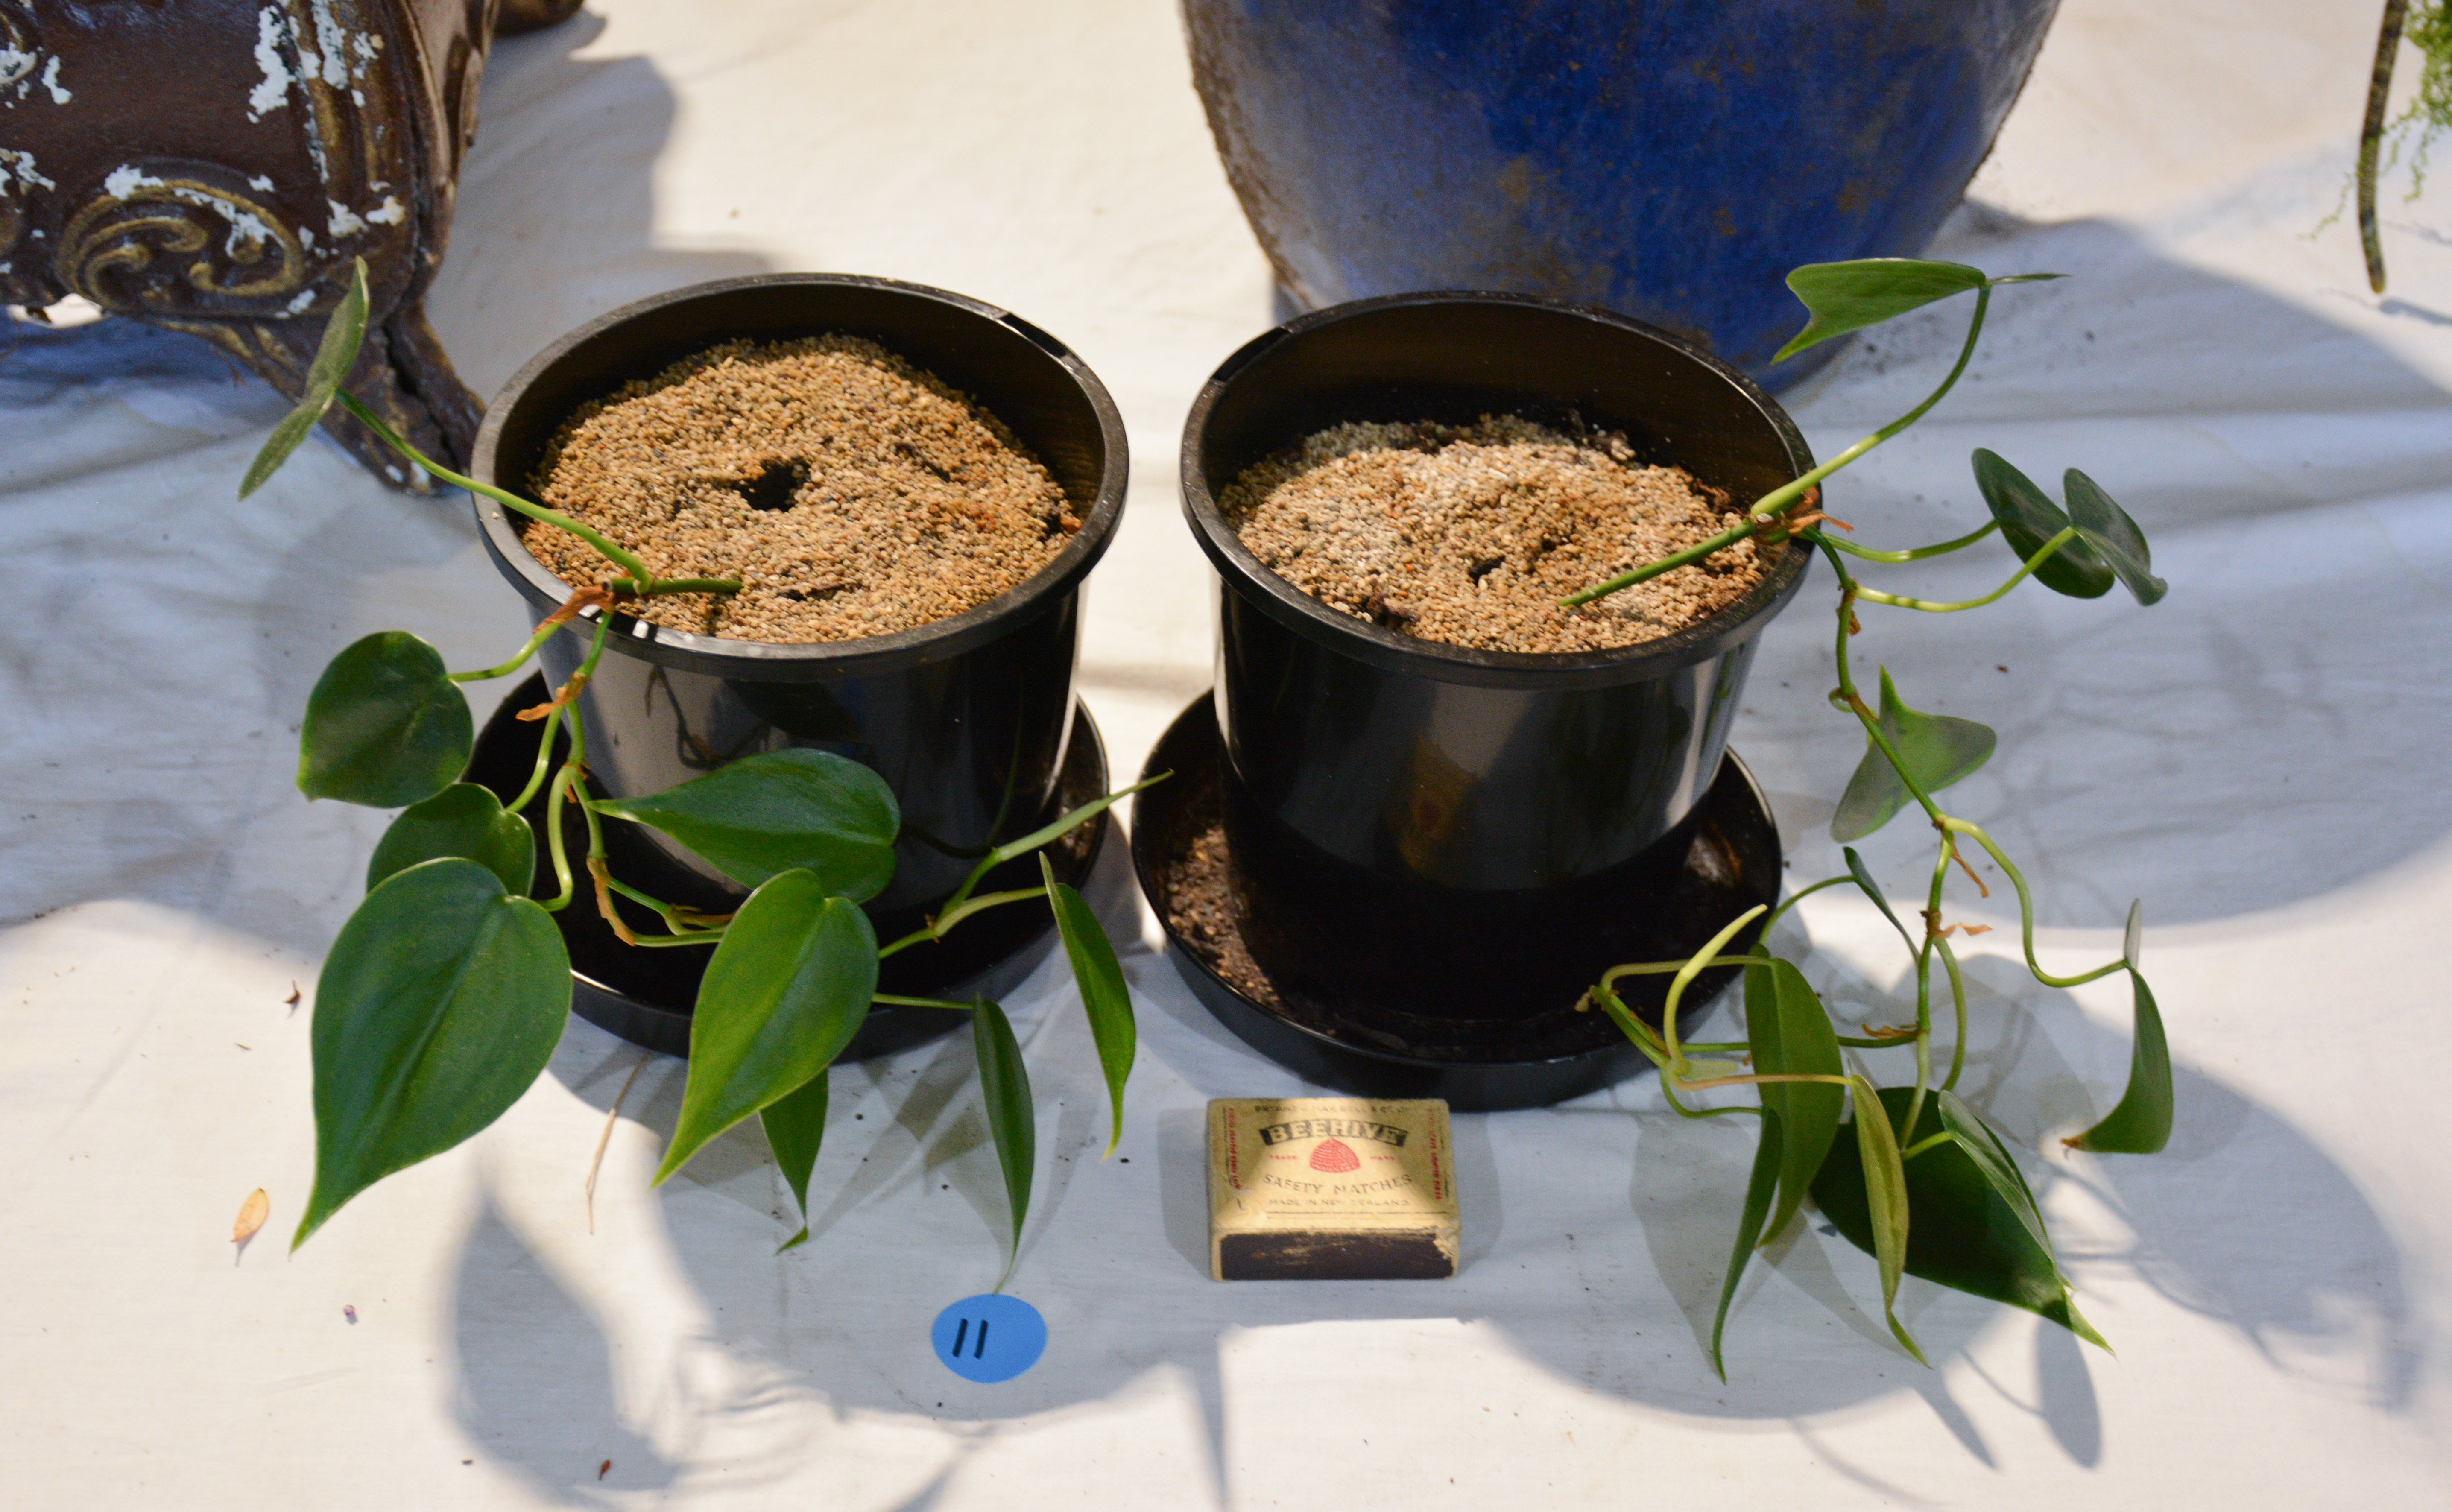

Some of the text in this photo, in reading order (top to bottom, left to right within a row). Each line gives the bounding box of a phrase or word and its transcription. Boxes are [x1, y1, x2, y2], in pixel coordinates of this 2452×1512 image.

[1269, 1120, 1398, 1144] BEEHIVE
[1263, 1173, 1412, 1195] SAFETY MATCHES
[952, 1318, 989, 1359] 11
